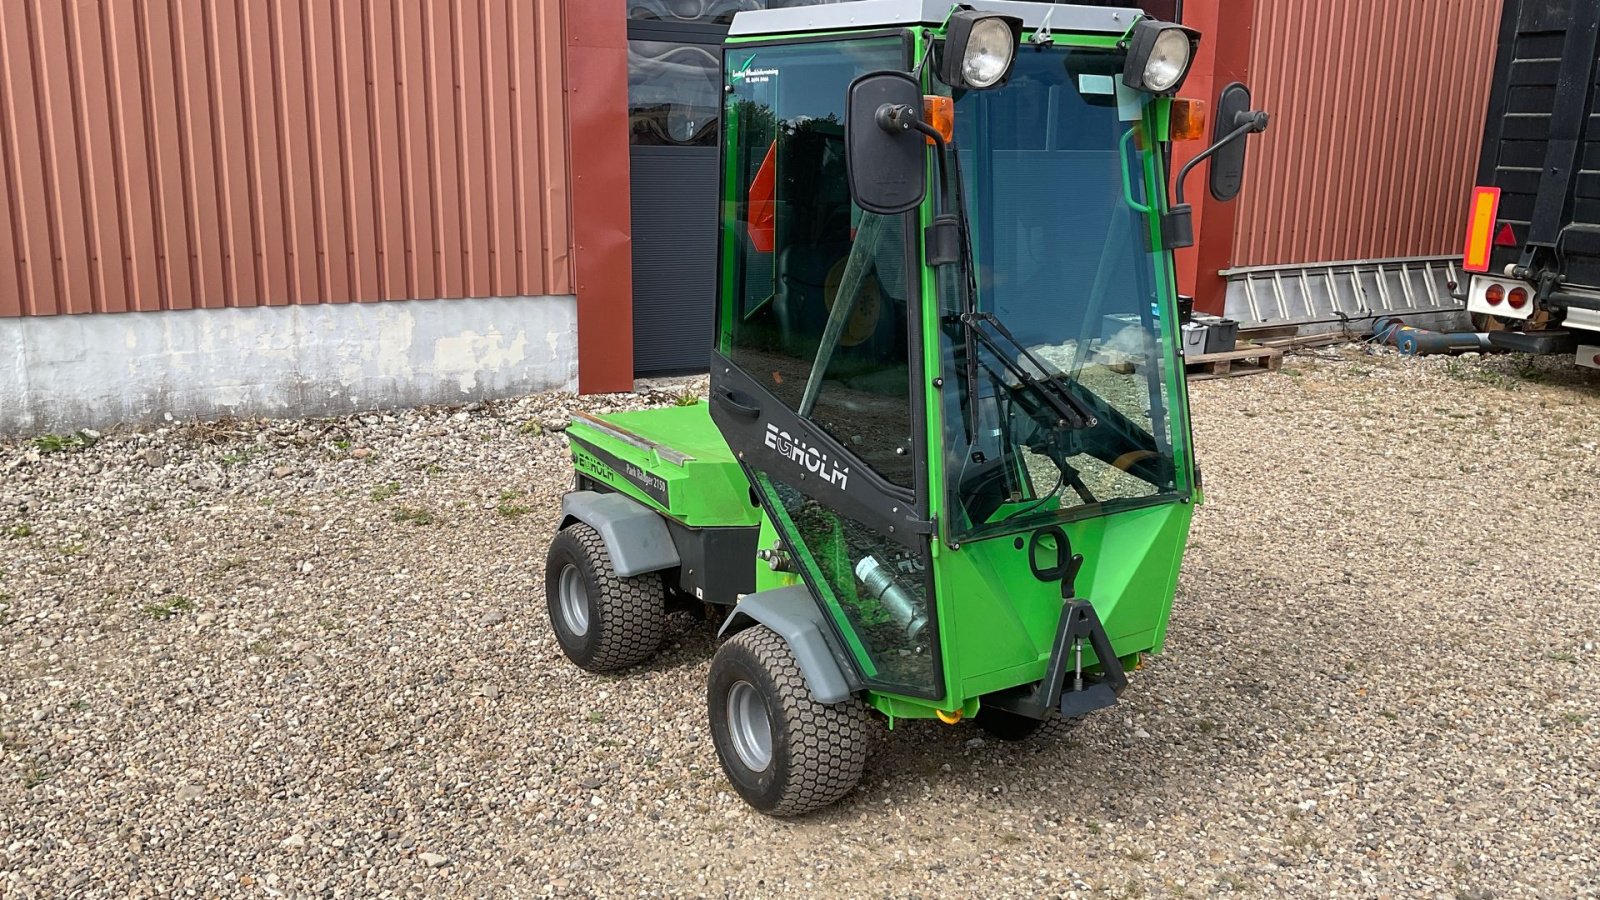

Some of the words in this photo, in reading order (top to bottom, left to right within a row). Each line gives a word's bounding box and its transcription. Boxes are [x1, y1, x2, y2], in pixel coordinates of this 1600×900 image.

[626, 463, 637, 477] Park
[653, 477, 666, 492] 2150
[764, 423, 849, 491] EGHOLM
